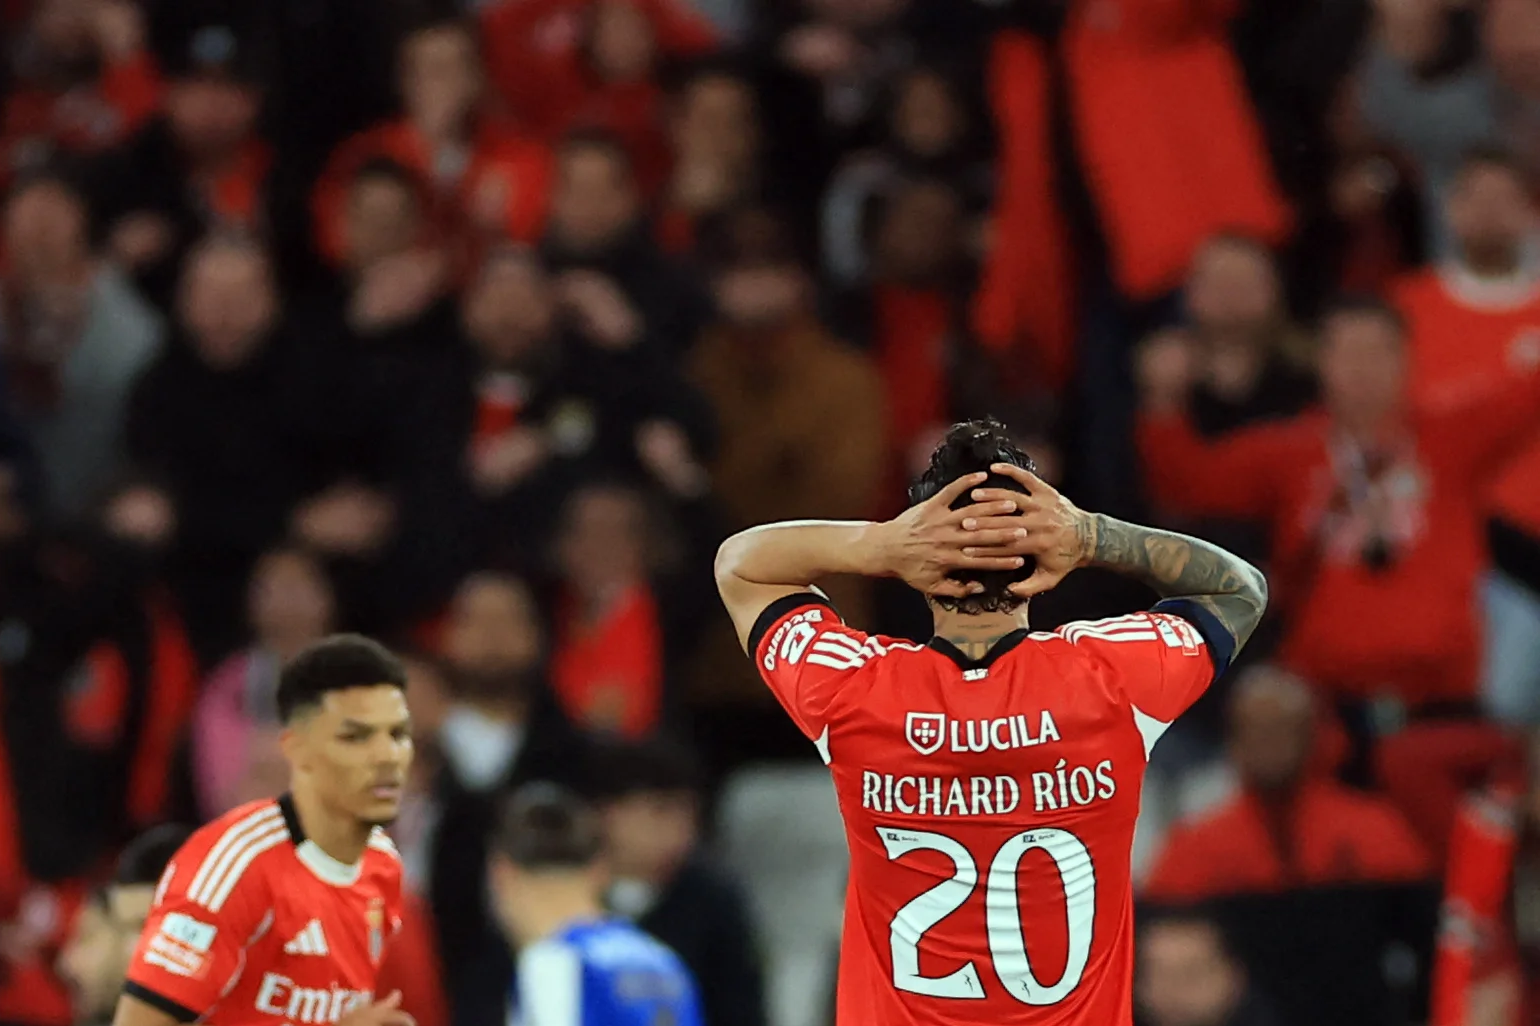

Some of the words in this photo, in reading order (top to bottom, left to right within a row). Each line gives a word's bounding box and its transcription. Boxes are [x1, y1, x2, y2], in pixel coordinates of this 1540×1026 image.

[950, 710, 1061, 753] LUCILA
[862, 770, 1020, 816] RICHARD
[1031, 757, 1116, 812] RÍOS
[875, 826, 1096, 1006] 20
[255, 970, 372, 1024] Emira
